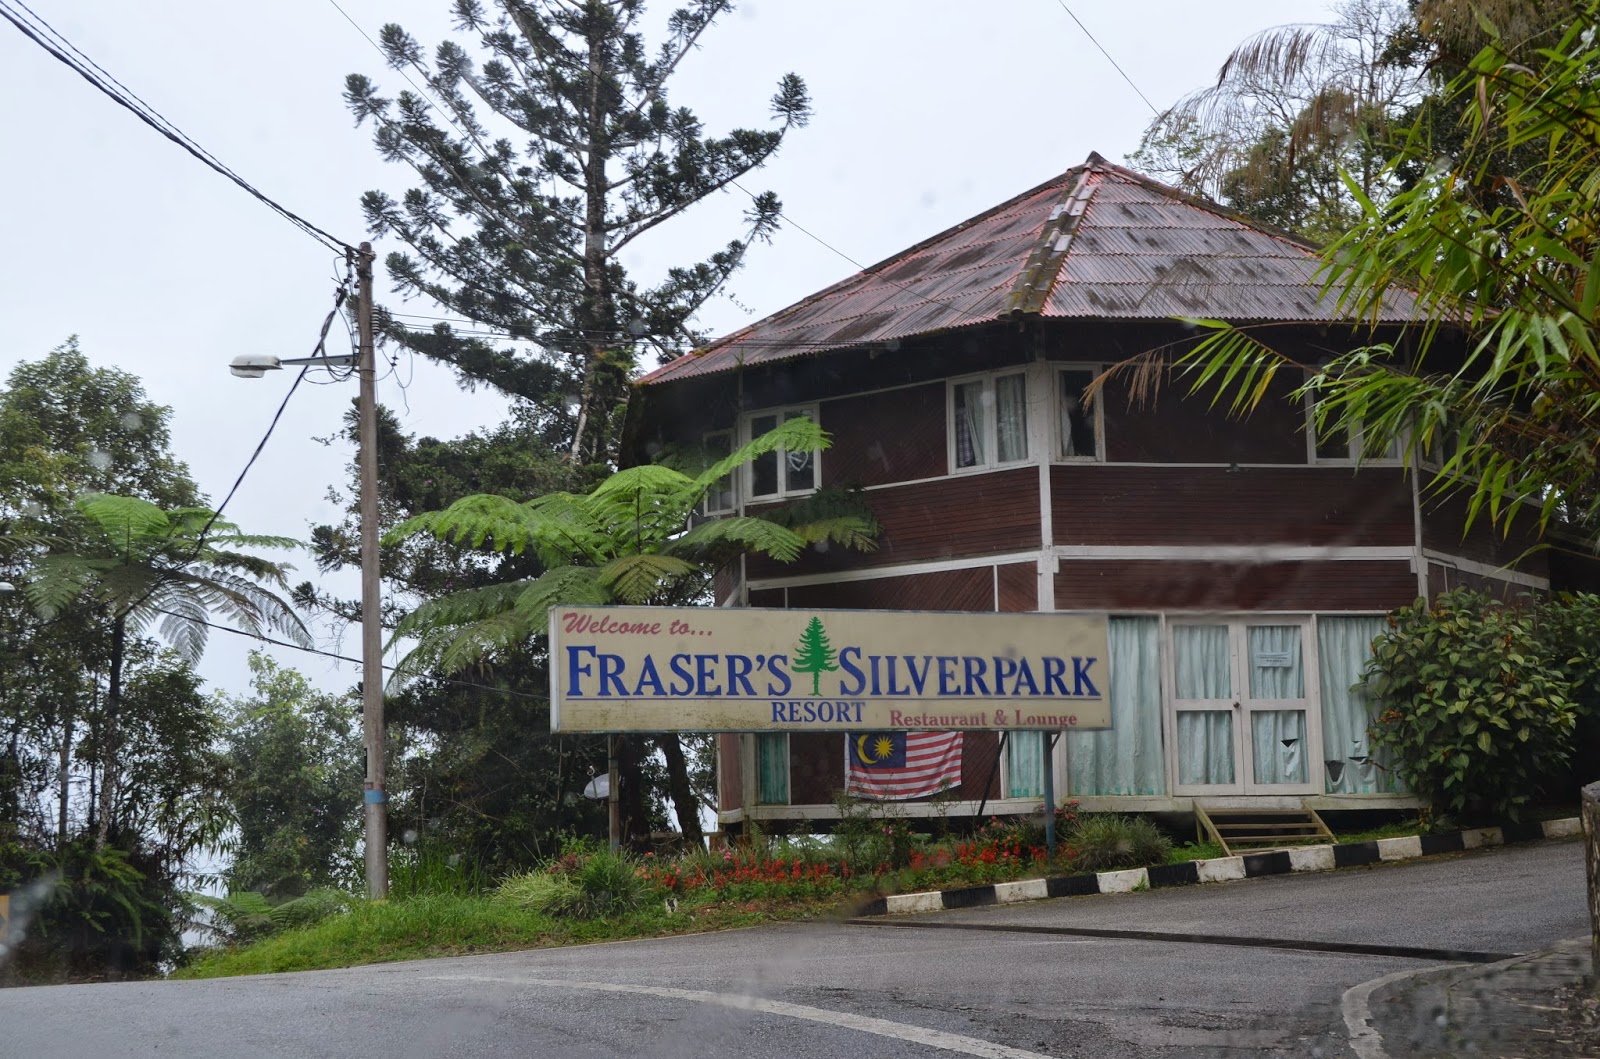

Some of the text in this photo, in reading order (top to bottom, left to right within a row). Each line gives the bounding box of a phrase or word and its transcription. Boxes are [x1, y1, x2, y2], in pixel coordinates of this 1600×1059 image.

[562, 612, 713, 636] Welcome to...
[565, 645, 1101, 697] FRASER'S SILVERPARK
[771, 701, 865, 723] RESORT
[889, 709, 1078, 728] Restaurant & Lounge
